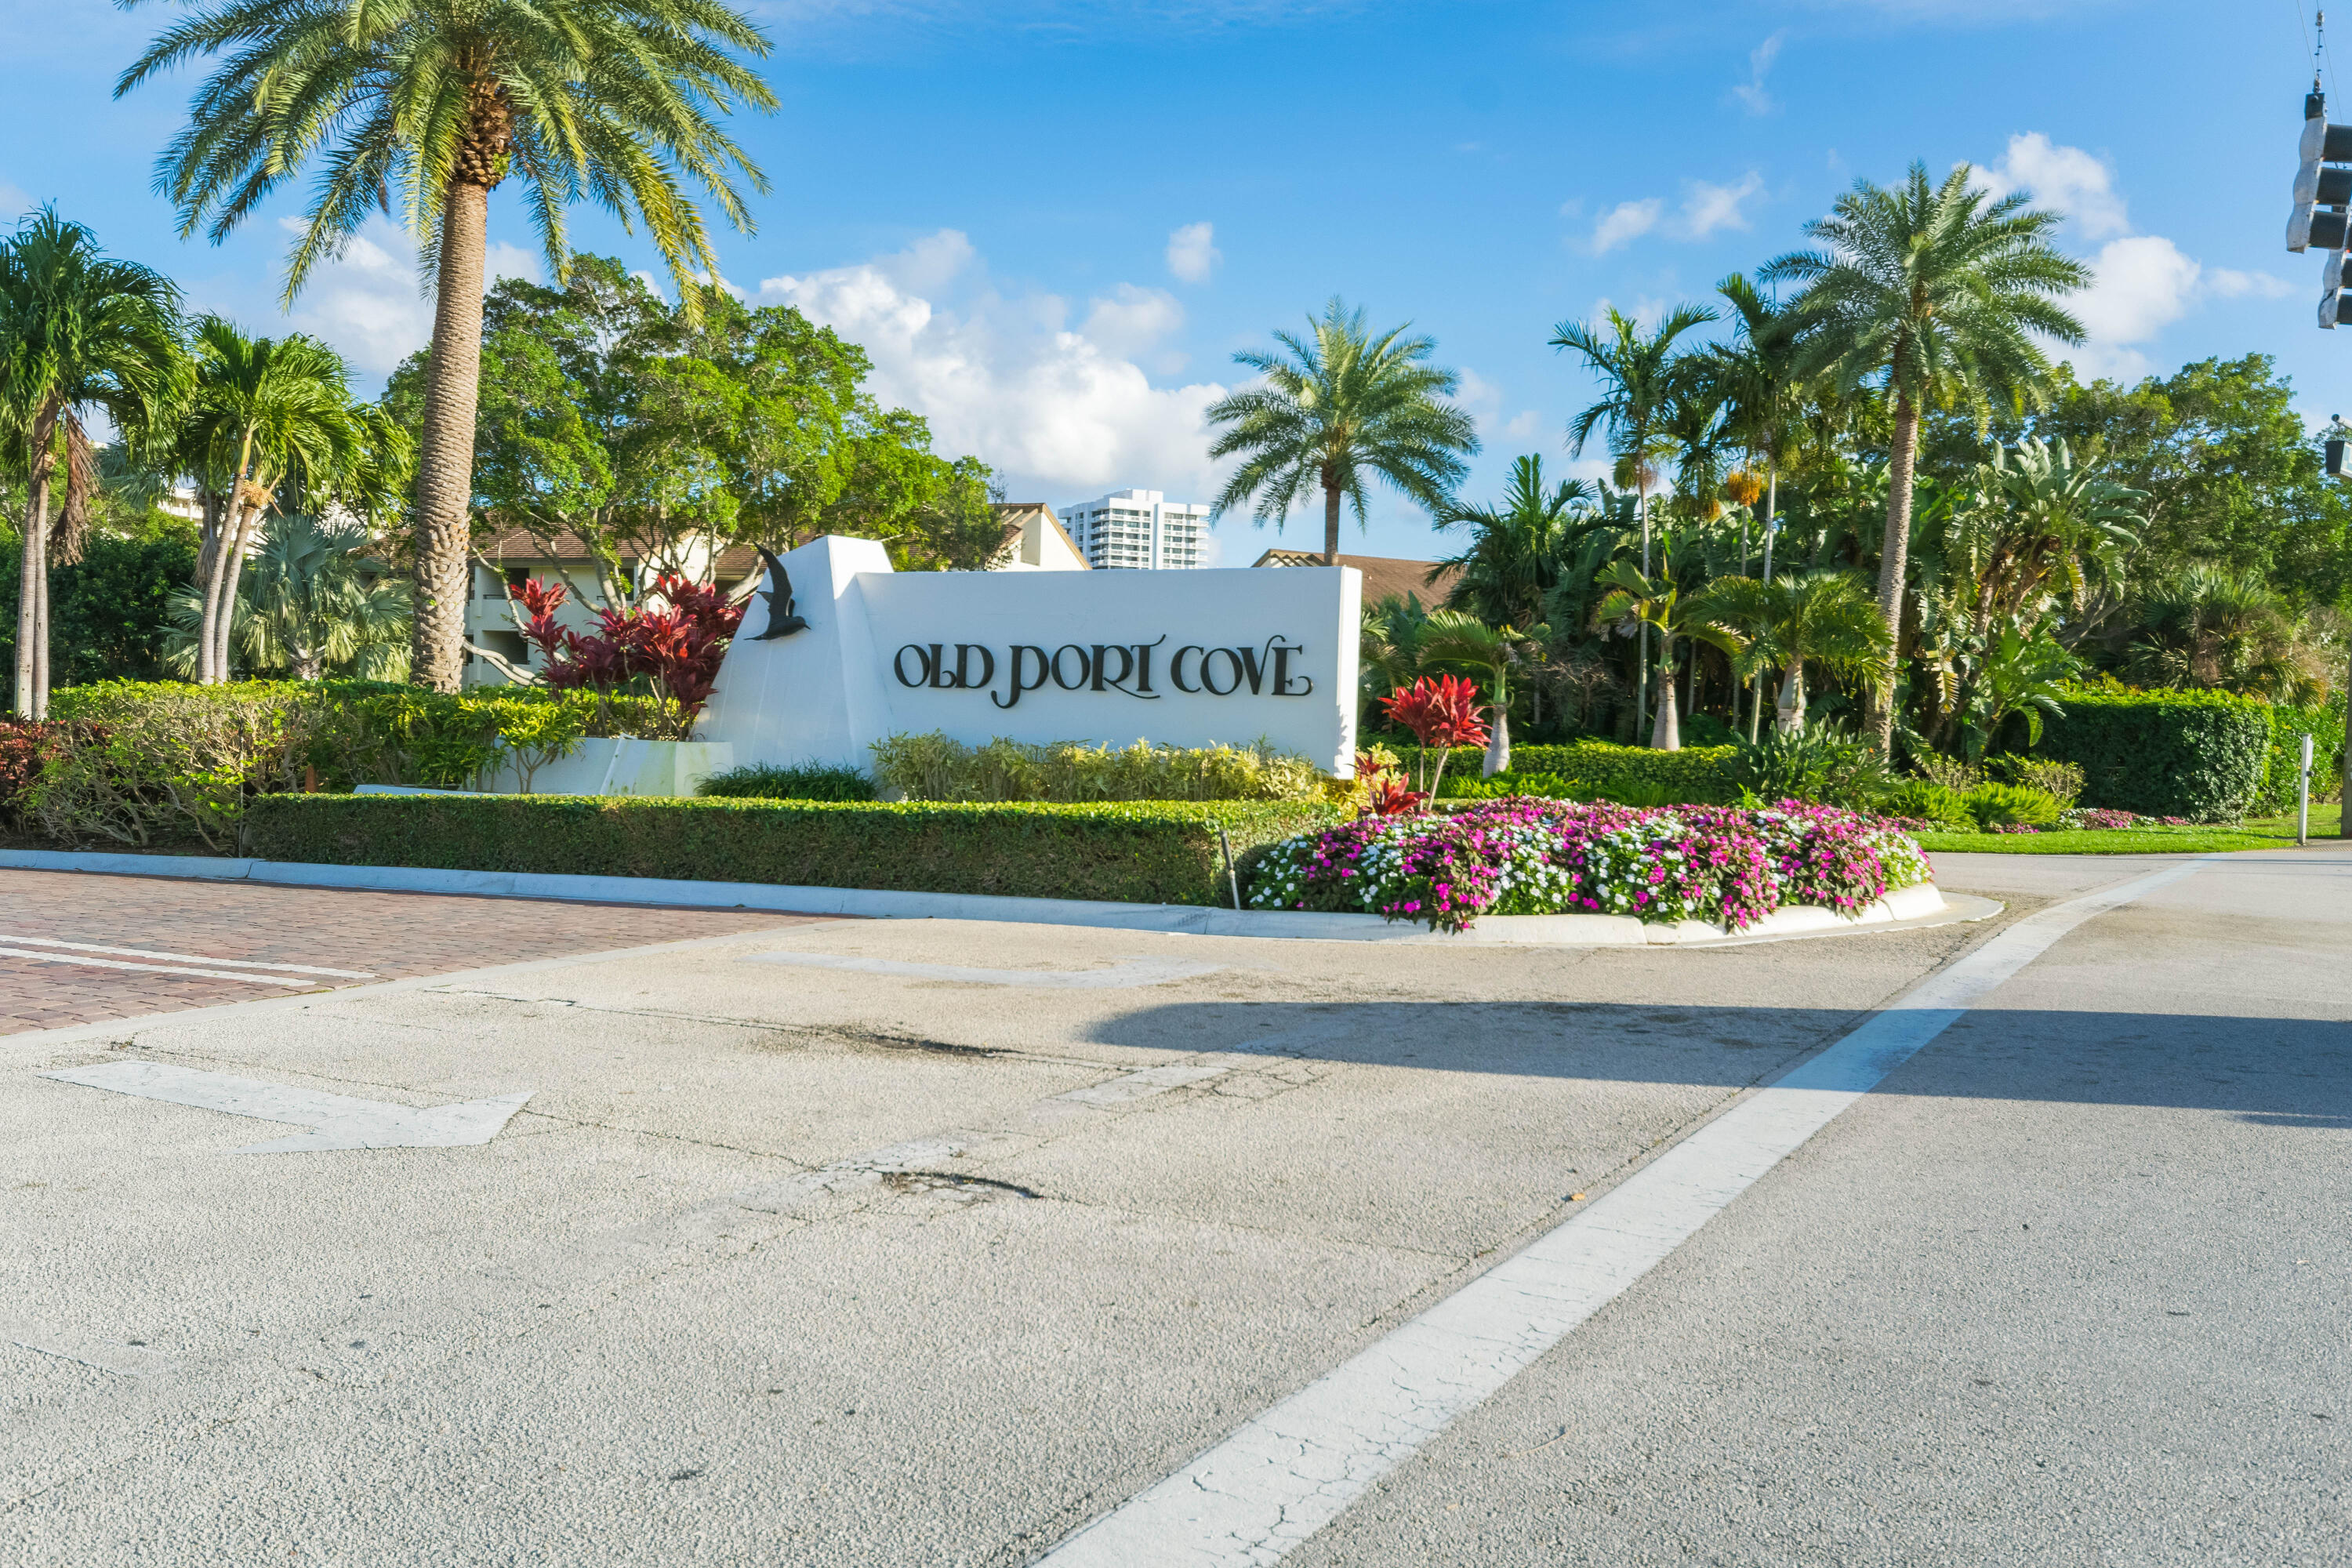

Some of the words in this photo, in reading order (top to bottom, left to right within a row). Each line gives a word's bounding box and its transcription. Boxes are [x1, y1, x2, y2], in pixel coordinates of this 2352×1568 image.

[893, 643, 995, 690] OLD
[990, 634, 1167, 710] PORT
[1170, 634, 1314, 697] COVE
